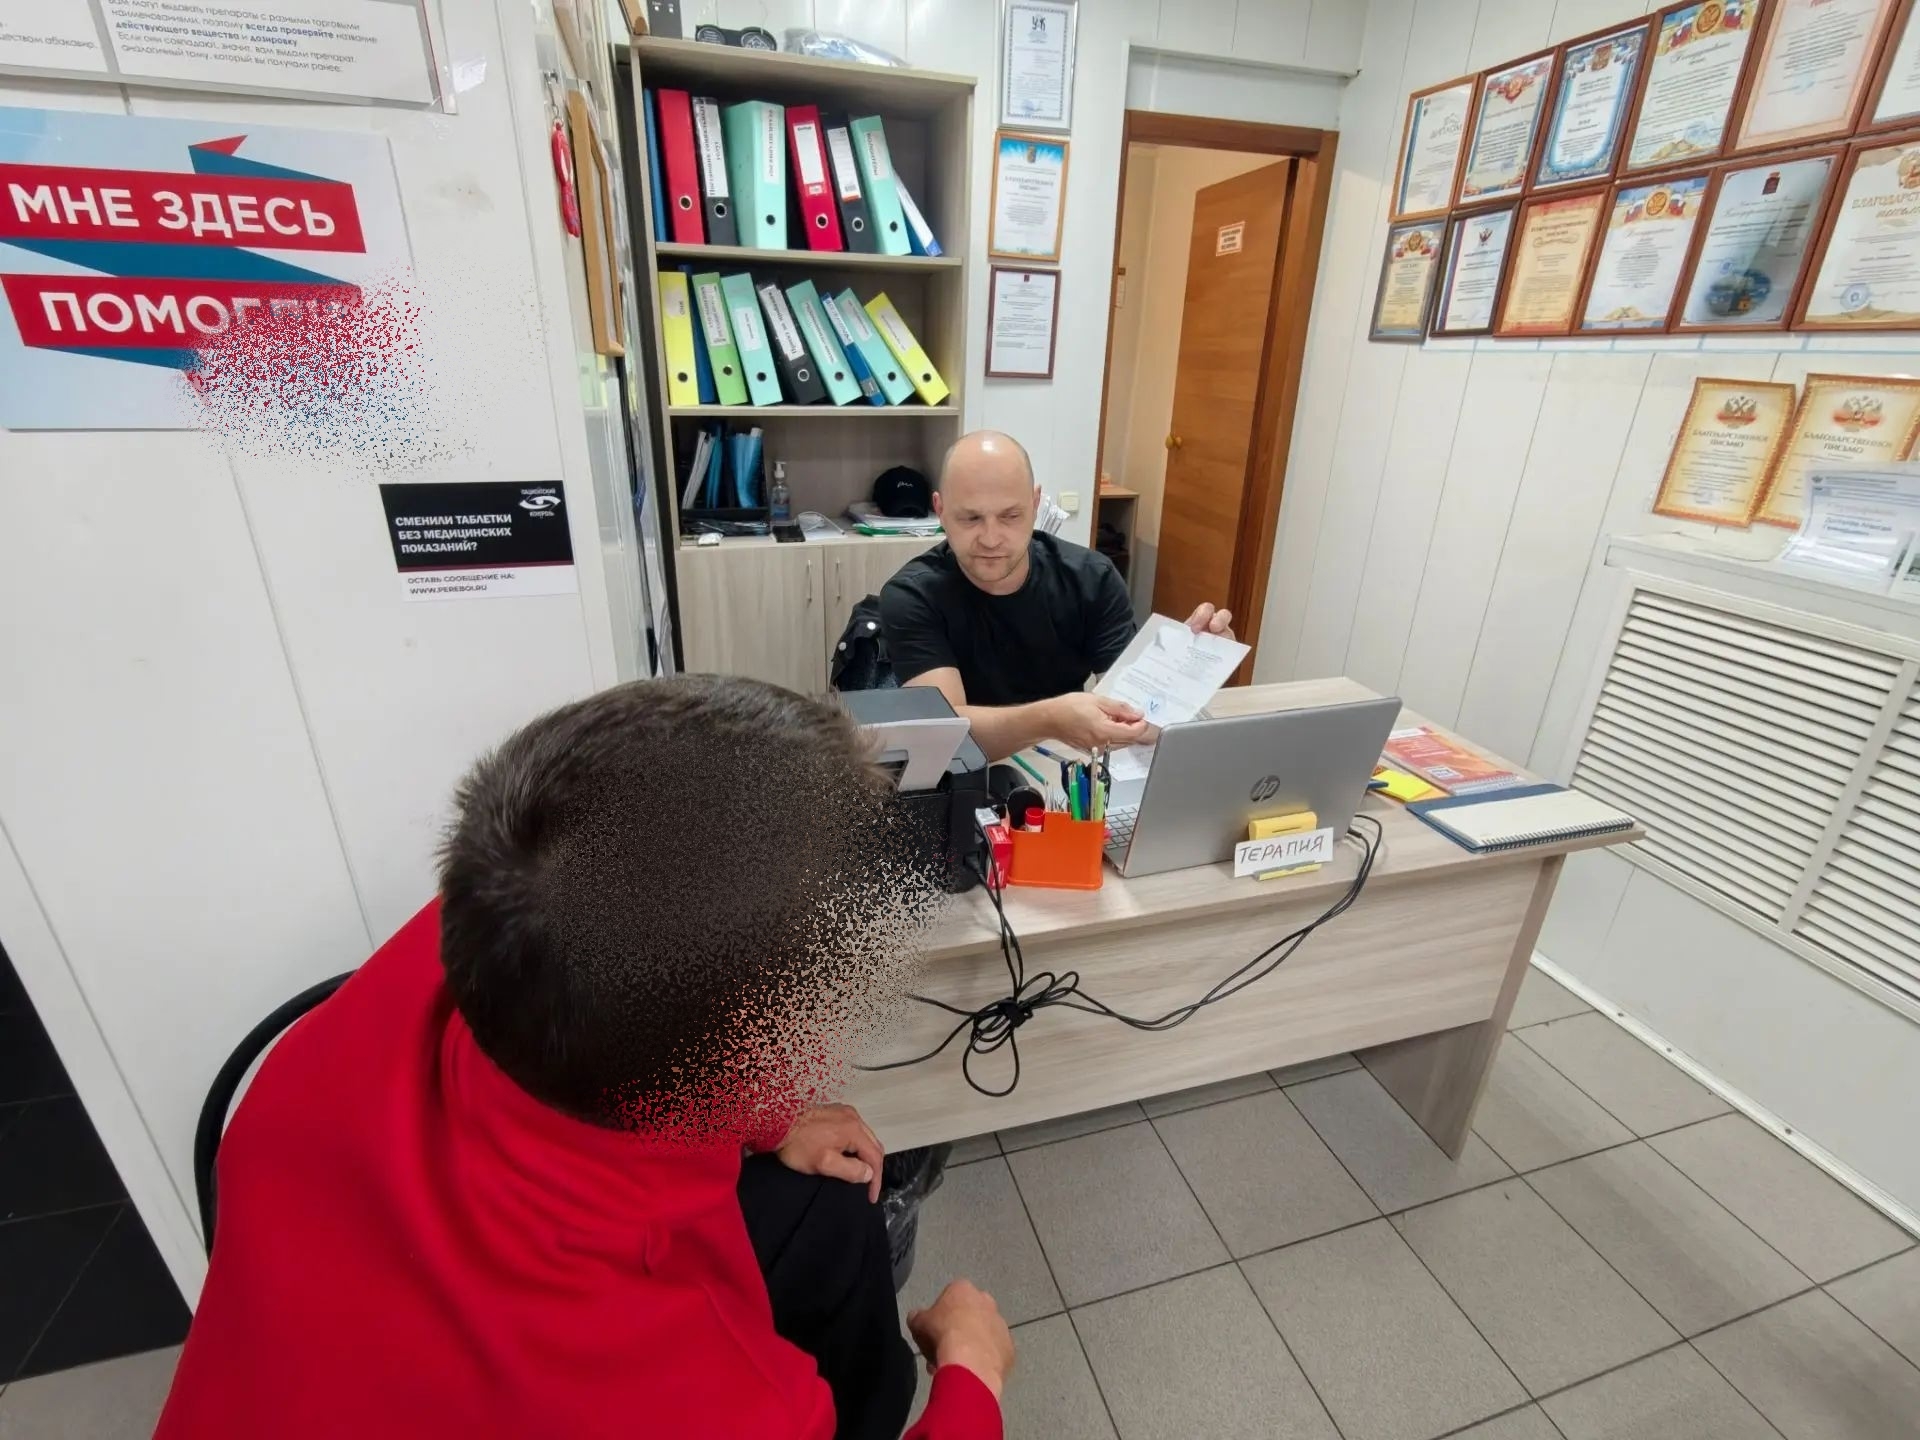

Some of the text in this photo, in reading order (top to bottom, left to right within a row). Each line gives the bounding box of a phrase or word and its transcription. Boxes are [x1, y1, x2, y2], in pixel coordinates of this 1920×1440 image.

[115, 20, 189, 35] действующего
[191, 28, 240, 40] вещества
[246, 22, 278, 33] всегда
[280, 25, 333, 39] проверяйте
[8, 183, 336, 239] МНЕ ЗДЕСЬ
[395, 513, 512, 527] СМЕНИЛИ ТАБЛЕТКИ
[398, 526, 512, 541] БЕЗ МЕДИЦИНСКИХ
[401, 540, 478, 554] ПОКАЗАНИЙ?
[408, 576, 442, 584] ОСТАВЬ
[444, 573, 499, 583] СООБЩЕНИЕ
[410, 584, 487, 595] WWW.PEREBOI.RU
[1240, 835, 1325, 865] ТЕРАПИЯ
